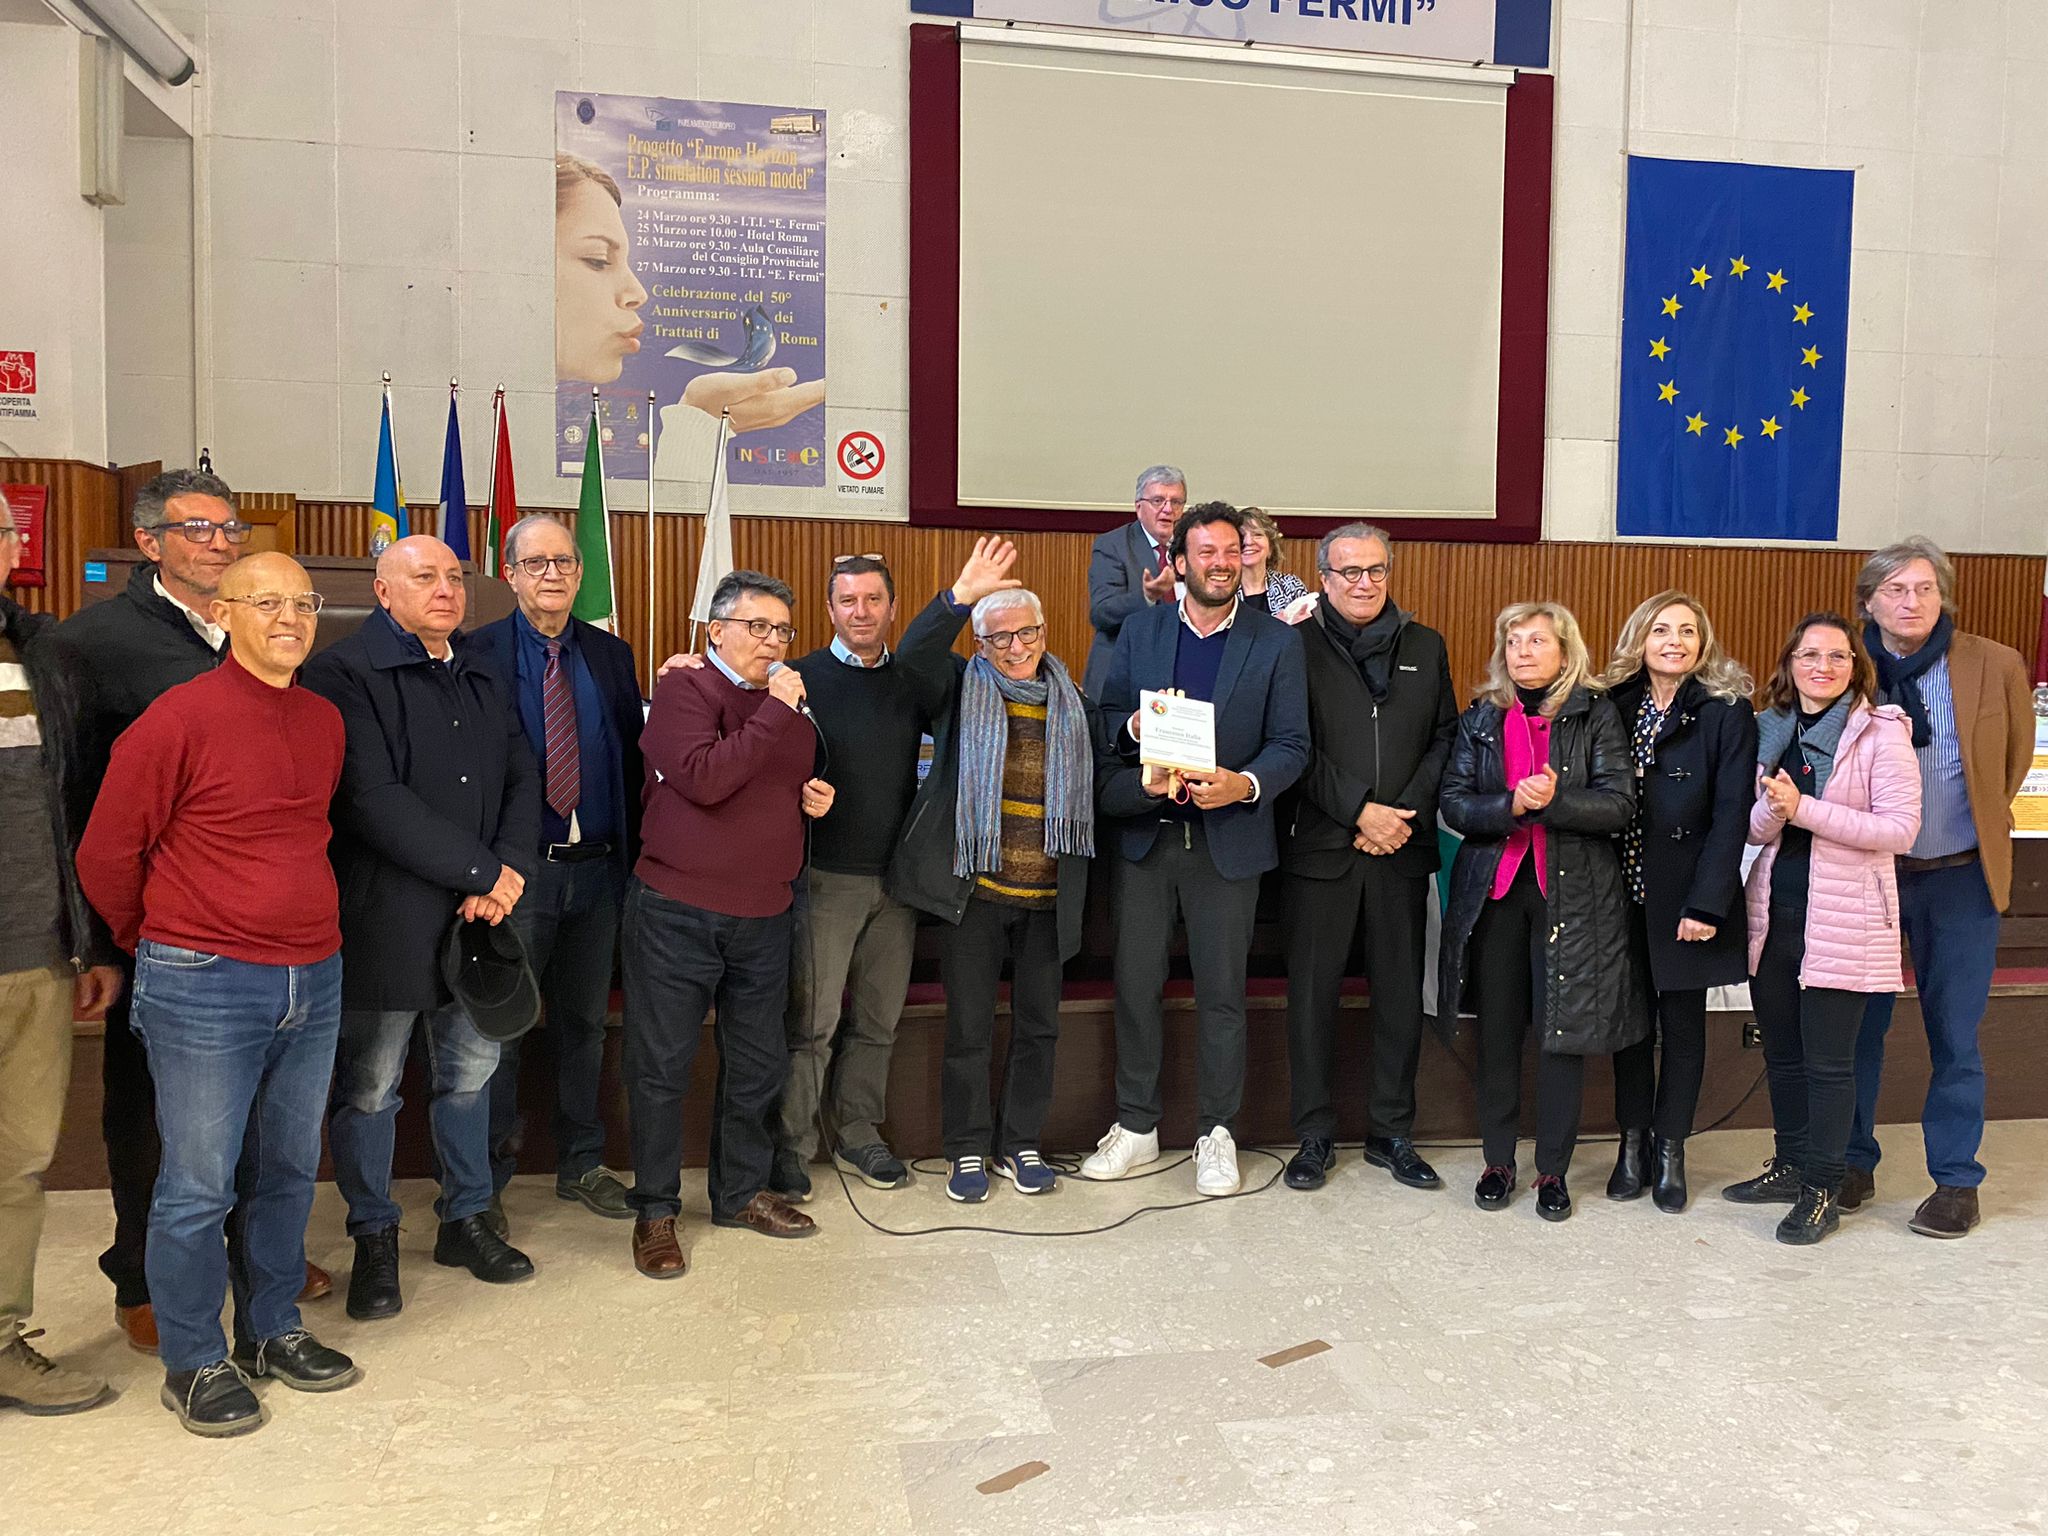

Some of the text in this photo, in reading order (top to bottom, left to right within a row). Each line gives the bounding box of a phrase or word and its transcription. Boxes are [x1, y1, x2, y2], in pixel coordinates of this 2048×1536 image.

[627, 133, 798, 166] Progetto “Europe Horizon
[627, 155, 815, 190] E.P. simulation session model”
[637, 185, 720, 201] Programma:
[637, 210, 649, 220] 24
[652, 211, 687, 223] Marzo
[689, 216, 707, 224] ore
[709, 214, 731, 226] 9.30
[740, 216, 766, 228] I.T.I.
[789, 219, 825, 231] Fermi”
[637, 223, 650, 233] 25
[652, 224, 687, 236] Marzo
[689, 229, 707, 237] ore
[710, 227, 737, 238] 10.00
[747, 229, 775, 241] Hotel
[777, 231, 808, 243] Roma
[636, 236, 649, 246] 26
[652, 237, 687, 249] Marzo
[689, 242, 707, 250] ore
[709, 240, 730, 252] 9.30
[739, 243, 765, 254] Aula
[767, 244, 819, 257] Consiliare
[692, 252, 820, 268] del Consiglio Provinciale
[636, 261, 649, 271] 27
[652, 262, 687, 274] Marzo
[689, 267, 707, 275] ore
[709, 266, 730, 277] 9.30
[740, 268, 765, 279] I.T.I.
[788, 270, 825, 282] Fermi”
[652, 284, 792, 304] Celebrazione del 50°
[652, 304, 793, 324] Anniversario dei
[652, 324, 719, 340] Trattati di
[780, 332, 818, 346] Roma
[0, 408, 37, 418] TIFIAMMA
[838, 485, 885, 495] VIETATO FUMARE
